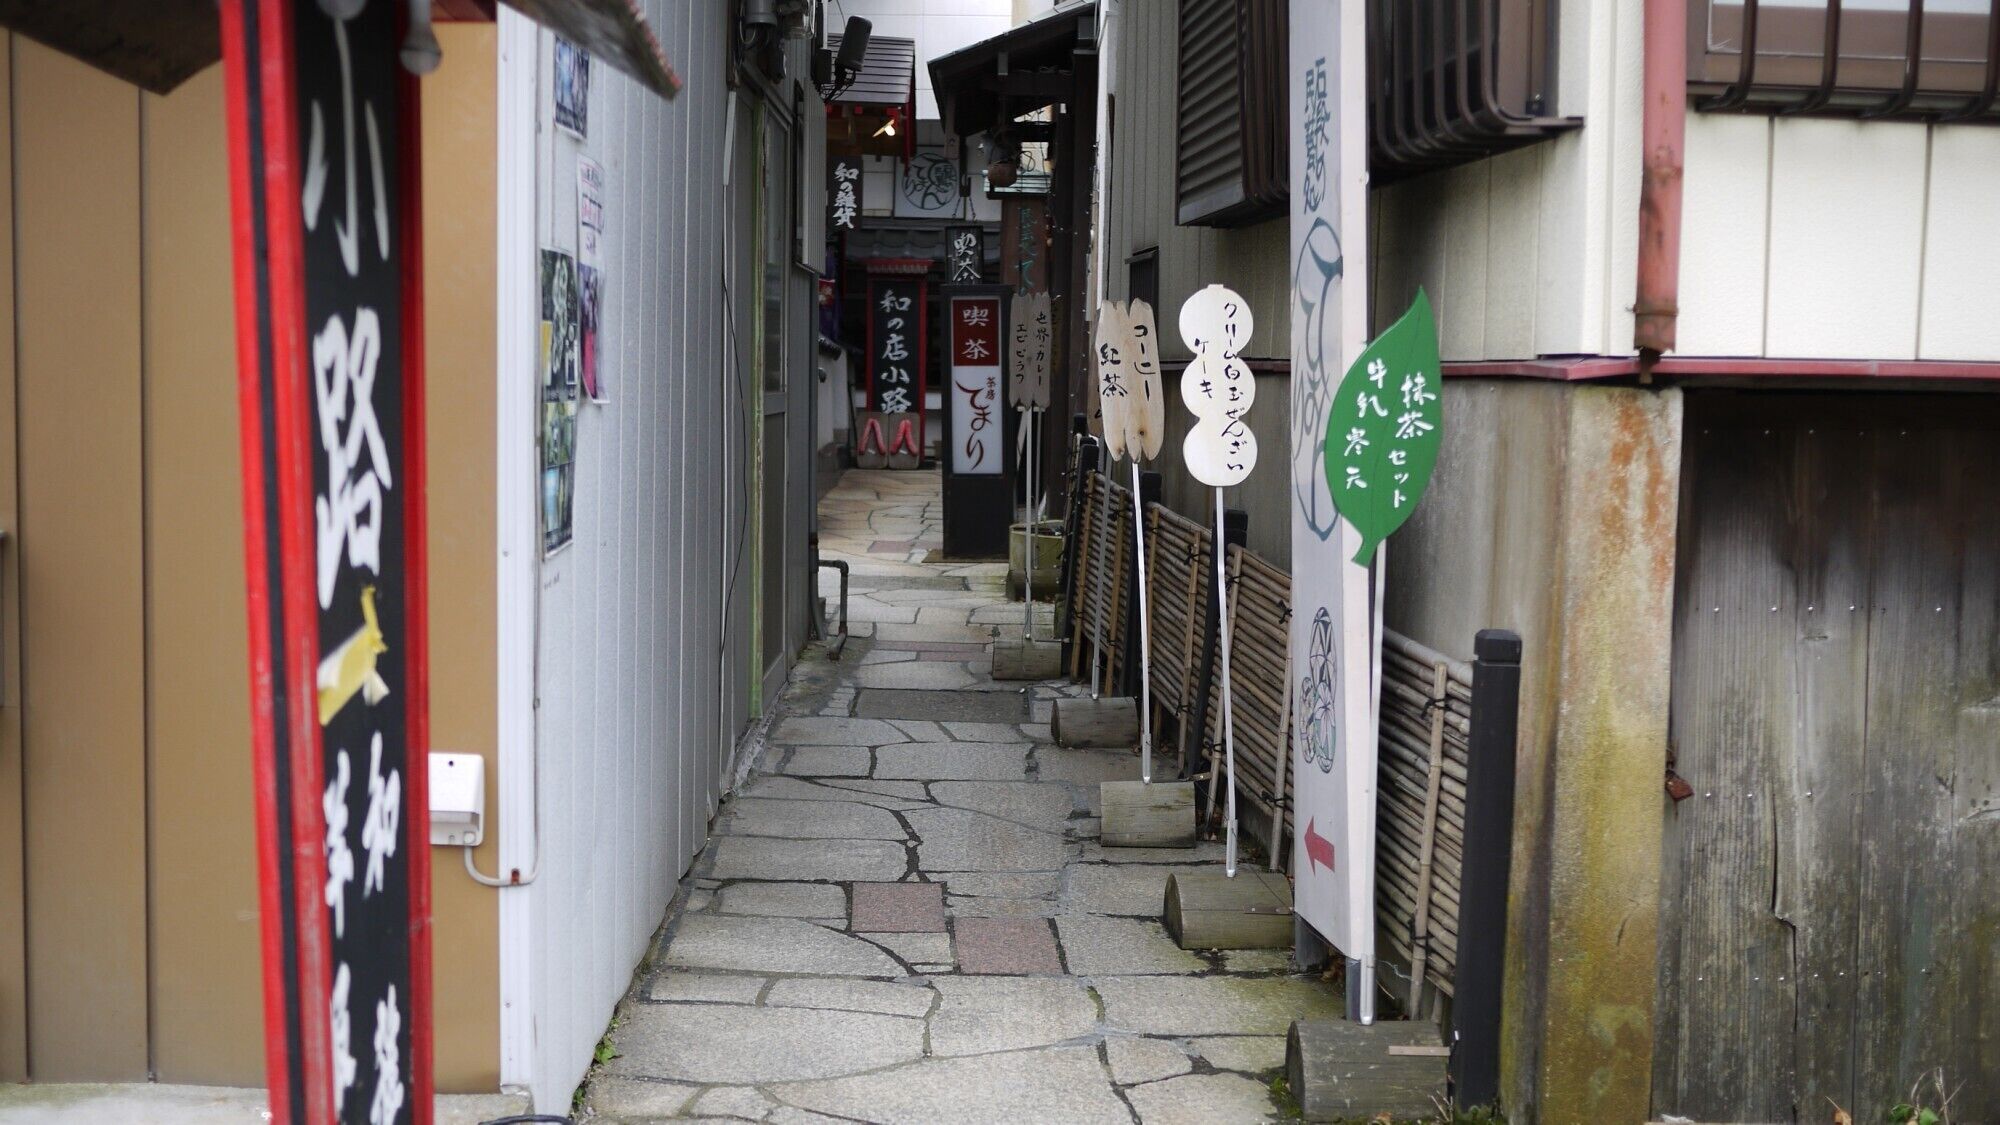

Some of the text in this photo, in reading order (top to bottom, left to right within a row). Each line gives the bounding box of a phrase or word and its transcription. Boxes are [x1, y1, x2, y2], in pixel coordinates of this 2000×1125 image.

[833, 162, 859, 229] 和の雑貨
[953, 232, 982, 282] 喫茶
[302, 19, 392, 610] 小路
[880, 288, 912, 415] 和の店小路
[961, 305, 990, 360] 喫茶
[985, 376, 997, 401] 茶房
[1100, 342, 1128, 397] 紅茶
[1133, 324, 1156, 402] コーヒー
[1194, 338, 1213, 399] ケーキ
[1221, 302, 1248, 471] クリーム白玉ぜんざい
[955, 380, 993, 470] てまり
[1344, 358, 1389, 490] 牛乳寒天
[1388, 372, 1437, 509] 抹茶セット
